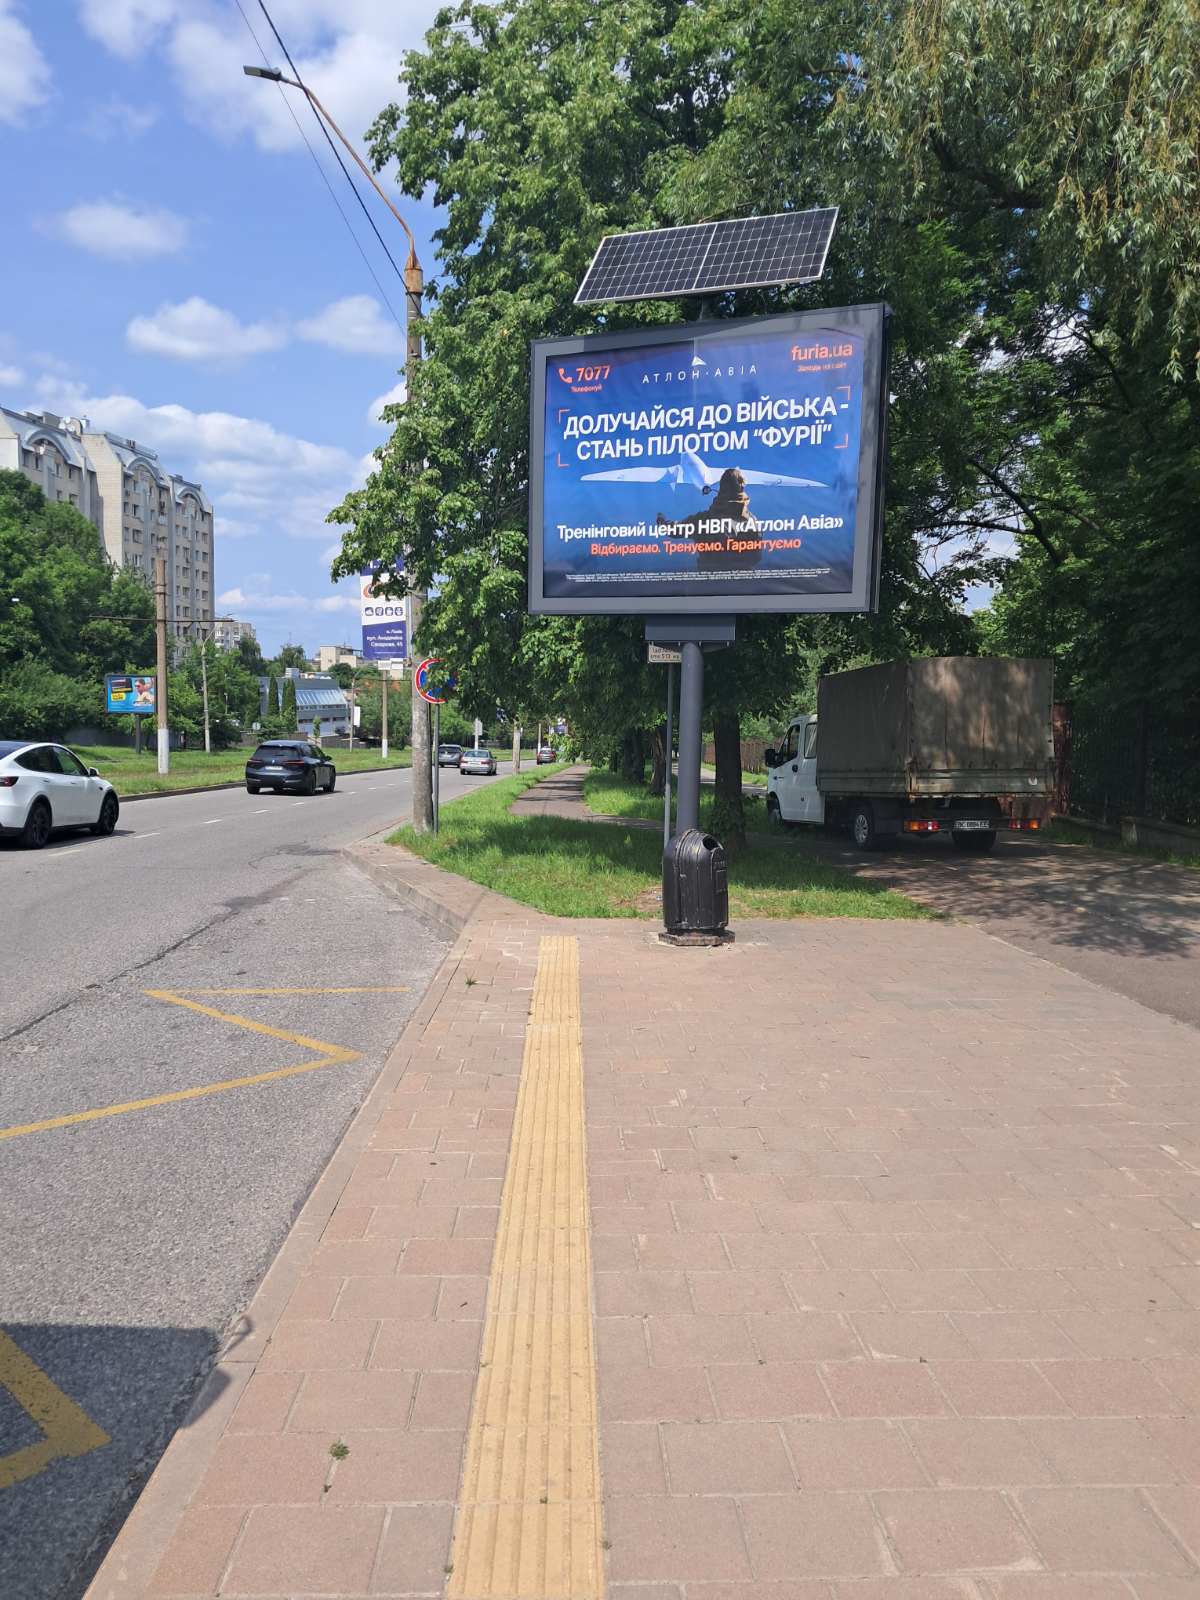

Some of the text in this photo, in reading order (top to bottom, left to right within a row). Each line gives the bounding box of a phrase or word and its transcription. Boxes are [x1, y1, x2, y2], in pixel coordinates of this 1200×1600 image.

[792, 343, 853, 361] furia.ua
[575, 365, 611, 382] 7077
[563, 404, 694, 440] ДОЛУЧАЙСЯ
[697, 404, 732, 431] ДО
[736, 395, 837, 423] ВІЙСЬКА
[576, 438, 644, 461] СТАНЬ
[647, 430, 749, 456] ПІЛОТОМ
[557, 514, 844, 542] Тренінговий центр НВП «Атлон Авіа»
[591, 538, 802, 557] Відбираємо. Тренуємо. Гарантуємо
